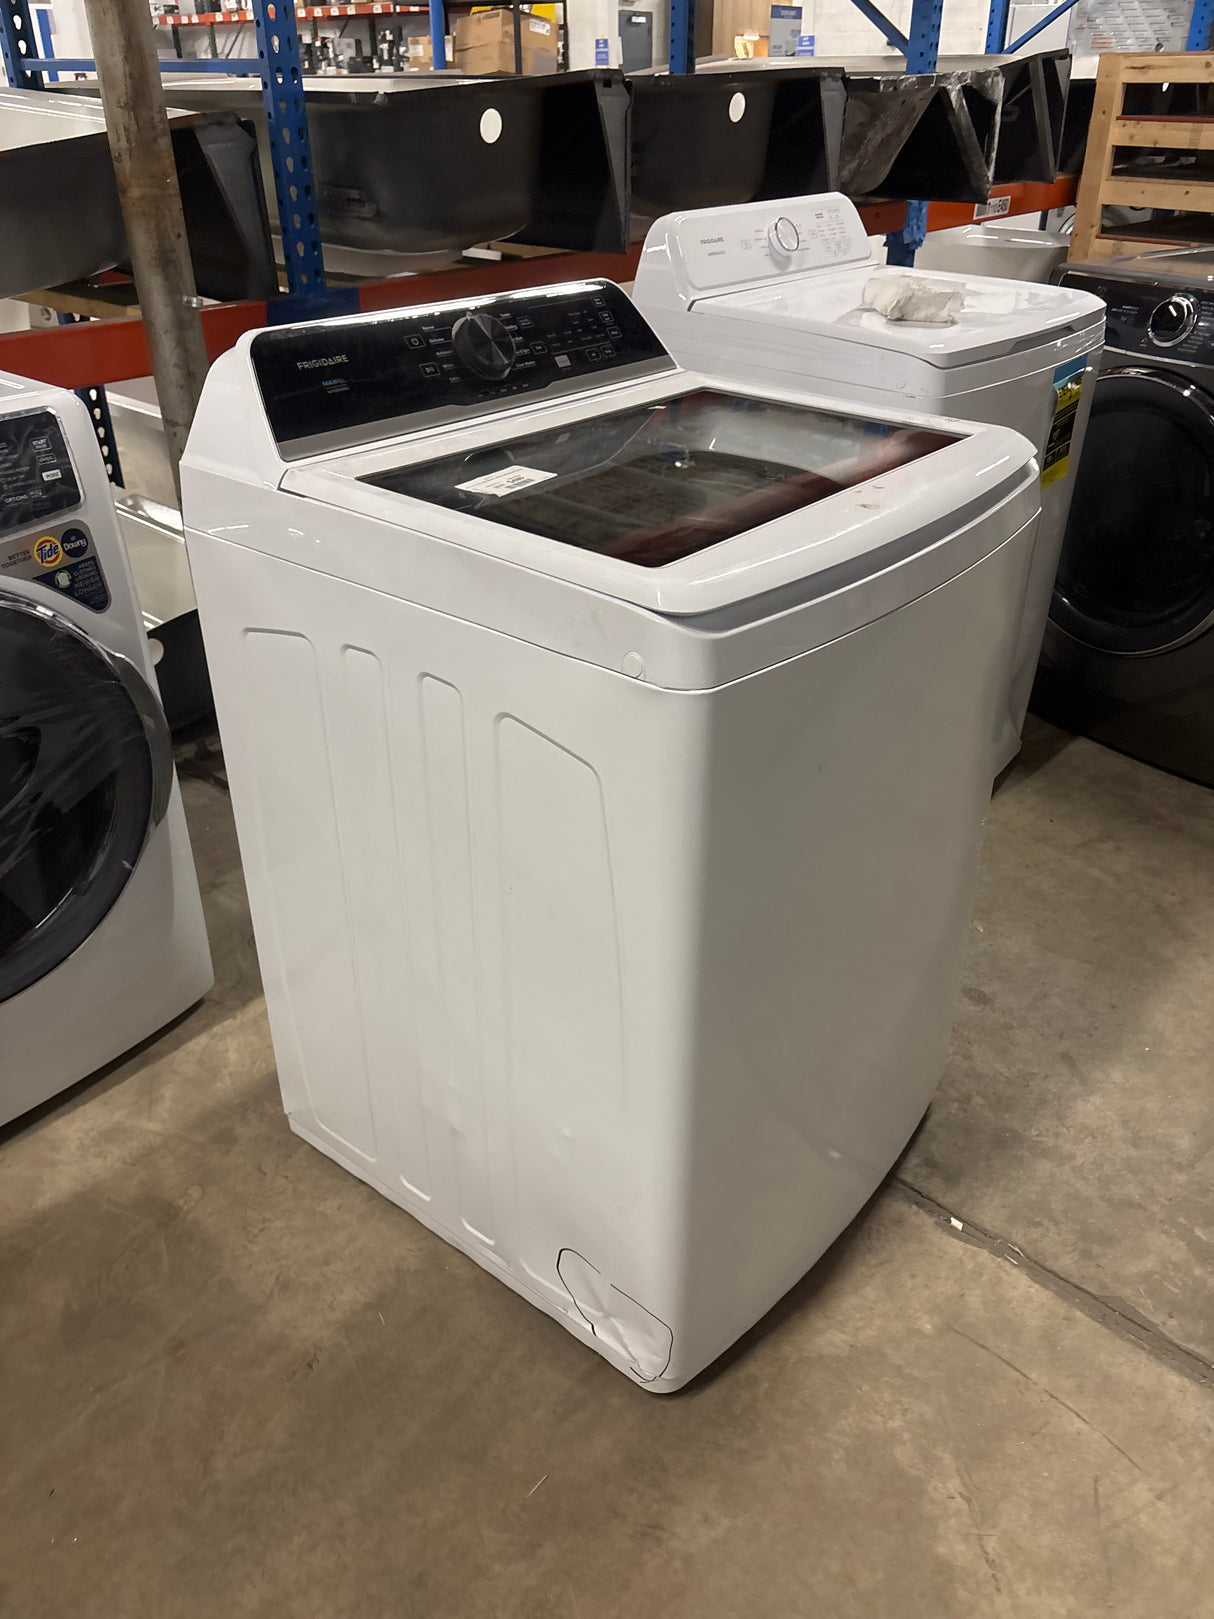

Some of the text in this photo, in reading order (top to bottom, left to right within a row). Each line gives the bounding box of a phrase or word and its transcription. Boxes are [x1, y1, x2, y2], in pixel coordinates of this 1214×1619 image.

[296, 354, 349, 370] FRIGIDAIRE
[4, 494, 28, 504] OPTIONS
[63, 538, 88, 551] Downy
[7, 549, 30, 561] BETTER
[36, 542, 59, 565] Tide
[1, 554, 32, 569] TOGETHER
